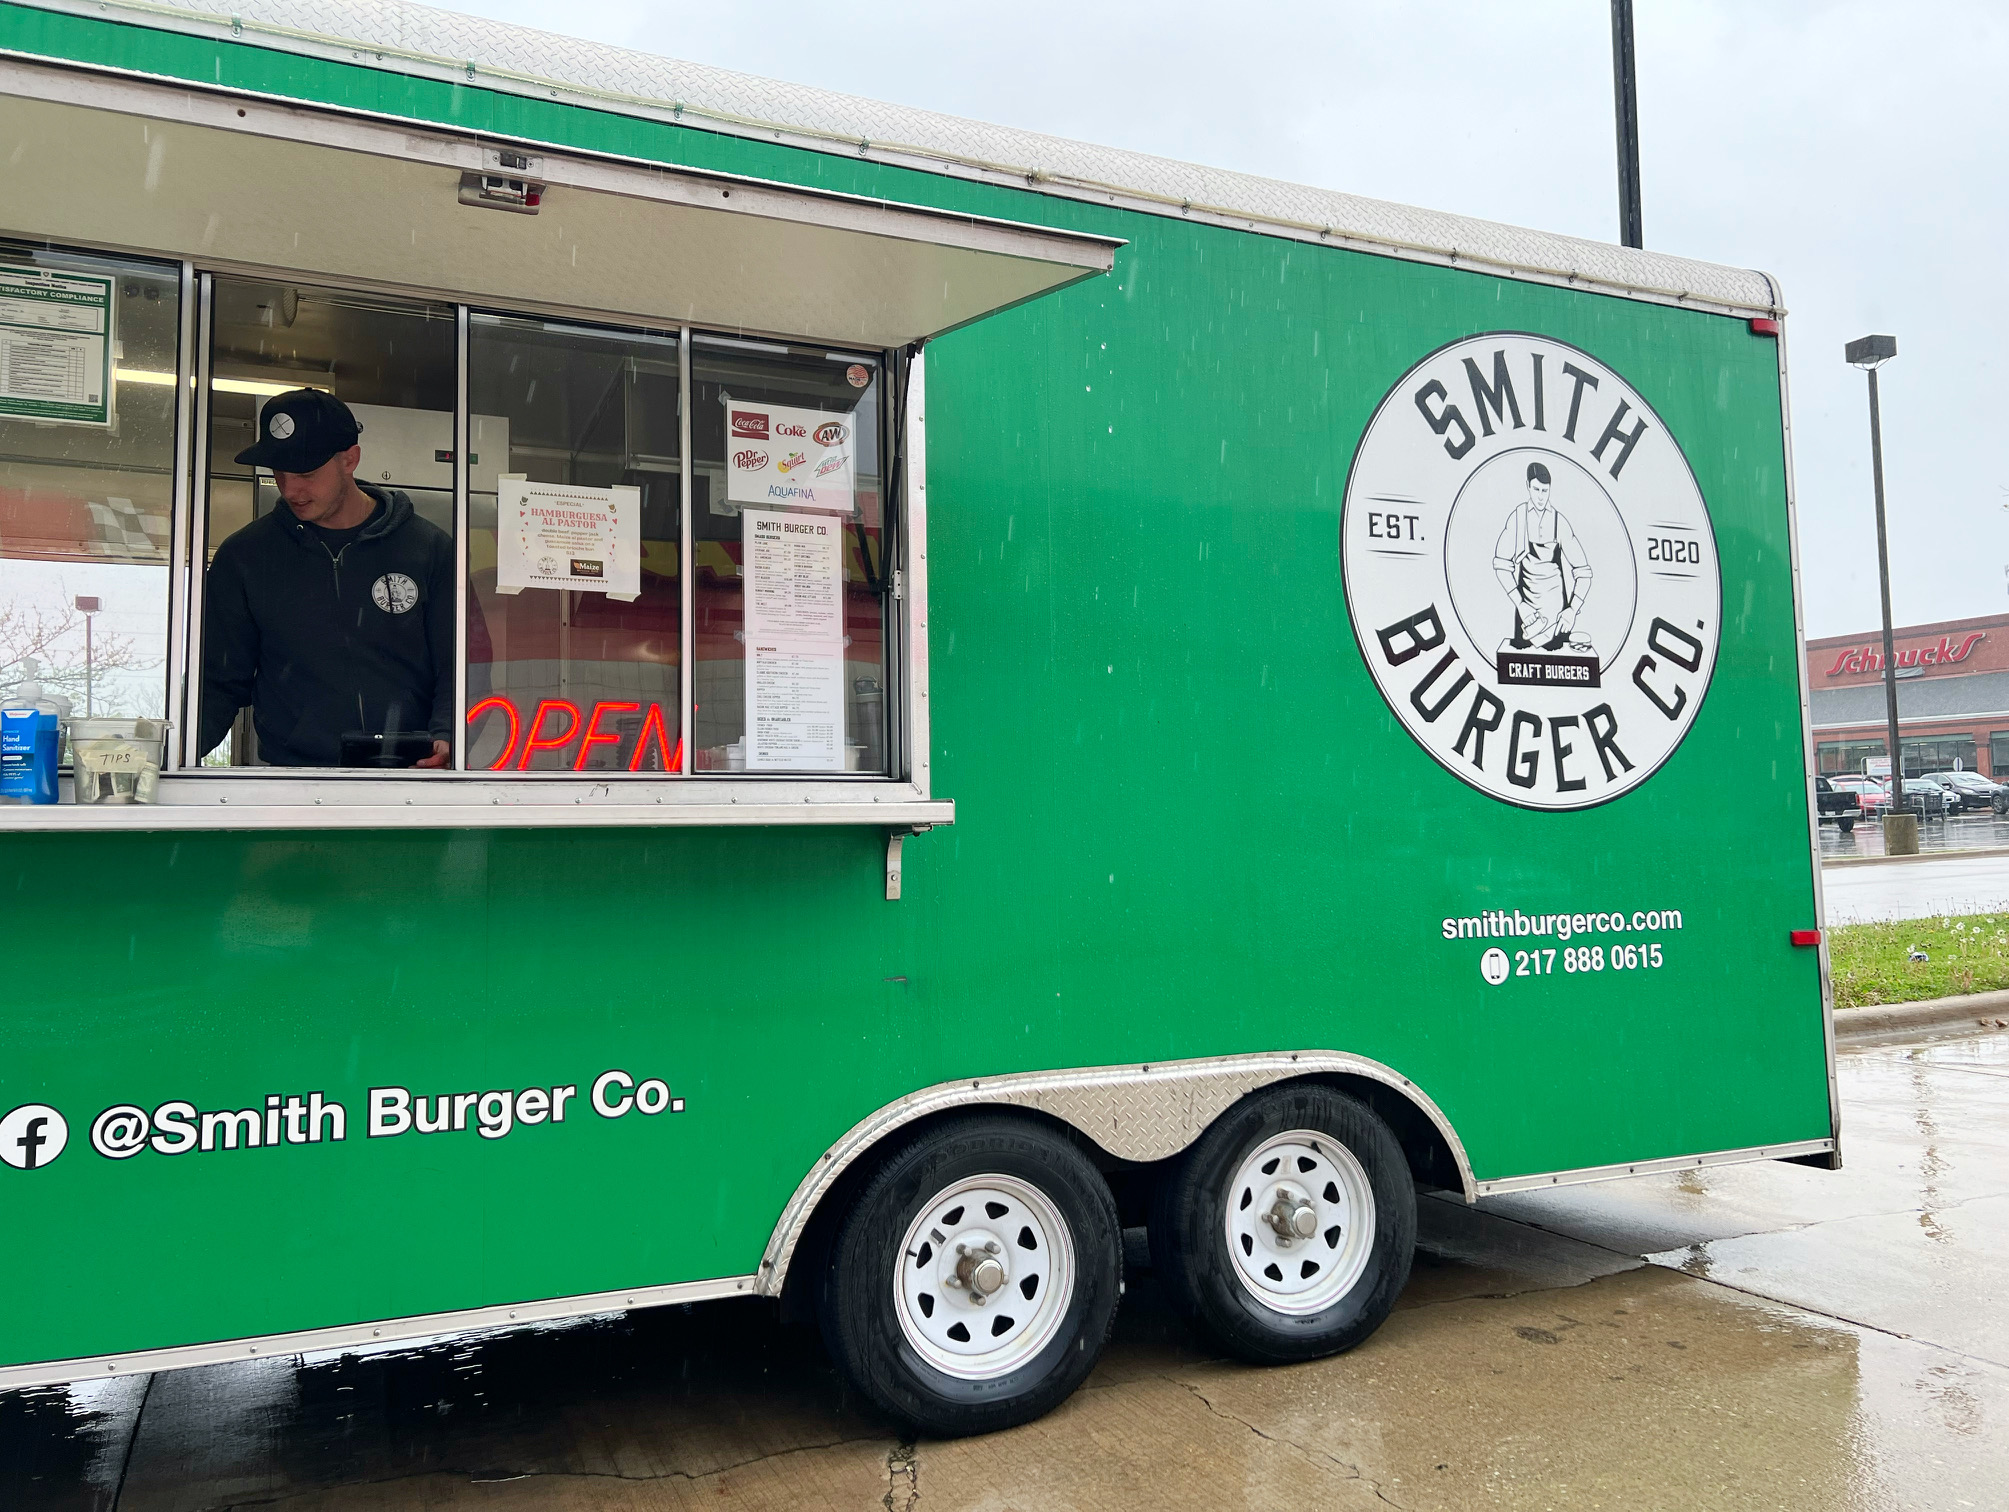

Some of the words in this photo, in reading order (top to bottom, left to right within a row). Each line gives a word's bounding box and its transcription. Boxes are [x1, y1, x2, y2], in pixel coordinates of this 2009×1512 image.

[50, 291, 104, 302] COMPLIANCE
[1414, 349, 1649, 481] SMITH
[776, 423, 807, 438] Coke
[737, 452, 766, 469] Pepper
[746, 450, 758, 462] Dr
[782, 452, 805, 470] Squirt
[768, 485, 815, 501] AQUAFINA
[531, 508, 608, 521] HAMBURGUESA
[542, 518, 555, 526] AL
[557, 519, 597, 529] PASTOR
[757, 521, 781, 532] SMITH
[784, 523, 814, 535] BURGER
[817, 526, 829, 536] CO.
[1368, 512, 1425, 541] EST.
[1647, 537, 1700, 563] 2020
[580, 562, 600, 570] Maize
[1508, 662, 1543, 679] CRAFT
[1545, 664, 1590, 681] BURGERS
[1375, 601, 1637, 794] BURGER
[1632, 616, 1706, 722] CO.
[100, 753, 131, 766] TIPS
[1442, 909, 1683, 940] smithburgerco.com
[1515, 949, 1556, 976] 217
[1564, 946, 1605, 973] 888
[1610, 943, 1664, 970] 0615
[89, 1091, 347, 1160] @Smith
[367, 1084, 577, 1140] Burger
[590, 1069, 686, 1119] Co.
